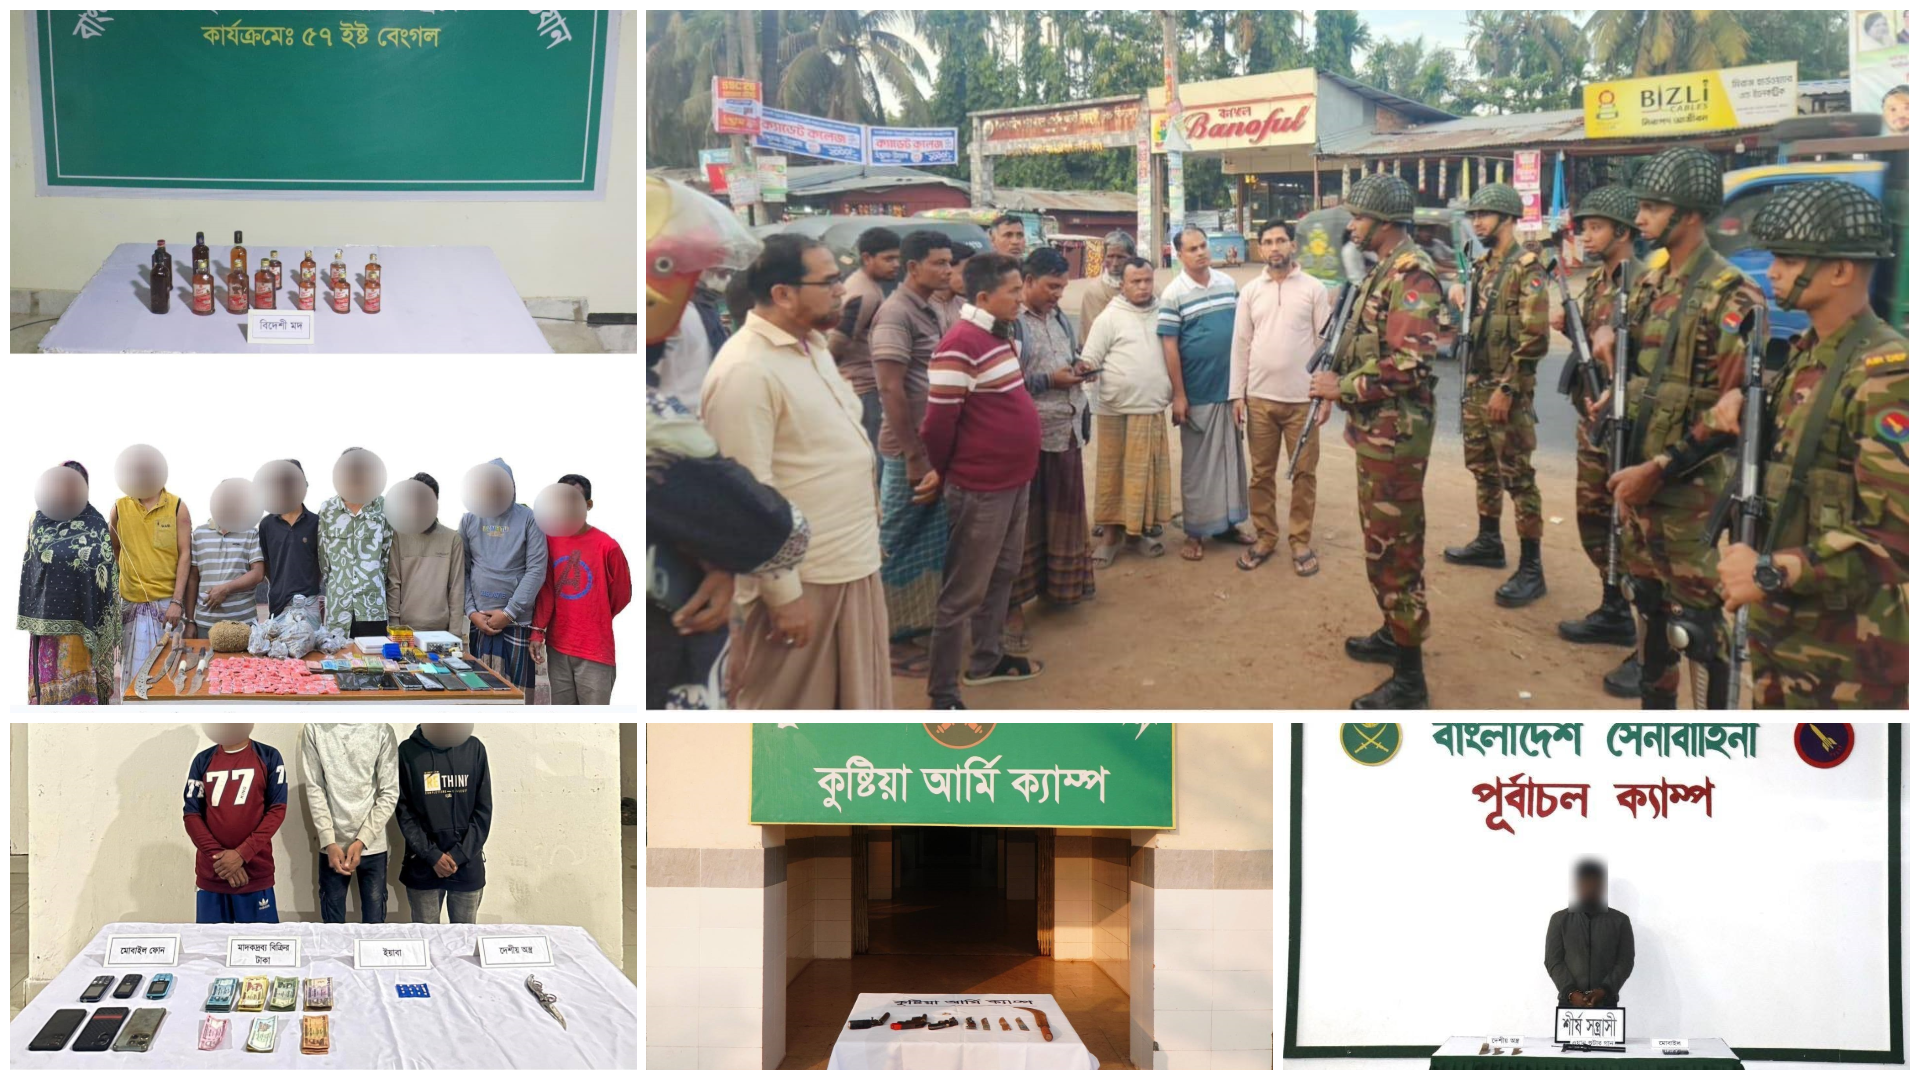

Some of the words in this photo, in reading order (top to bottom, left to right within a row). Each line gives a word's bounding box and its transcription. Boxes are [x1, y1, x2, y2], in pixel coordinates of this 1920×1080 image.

[200, 19, 294, 47] কার্যক্রমেঃ
[302, 27, 333, 48] ৫৭
[340, 20, 369, 48] ইষ্ট
[377, 26, 441, 48] বেংগল
[1670, 102, 1709, 112] CABLES
[762, 120, 805, 137] ক্যাডেট
[807, 130, 847, 144] কলেজ
[1183, 105, 1311, 145] Banoful
[259, 319, 287, 331] বিদেশী
[290, 319, 303, 331] মদ
[1432, 723, 1584, 758] বাংলাদেশ
[206, 768, 255, 807] 77
[813, 755, 913, 813] কুষ্টিয়া
[920, 755, 1002, 804] আর্মি
[1007, 764, 1111, 804] ক্যাম্প
[1472, 772, 1591, 835] পূর্বাচল
[1613, 776, 1715, 819] ক্যাম্প
[120, 944, 147, 955] মোবাইল
[149, 945, 165, 955] ফোন
[255, 954, 271, 965] টাকা
[382, 946, 402, 957] ইয়াবা
[499, 944, 520, 955] দেশীয়
[1561, 1011, 1584, 1036] শীর্ষ
